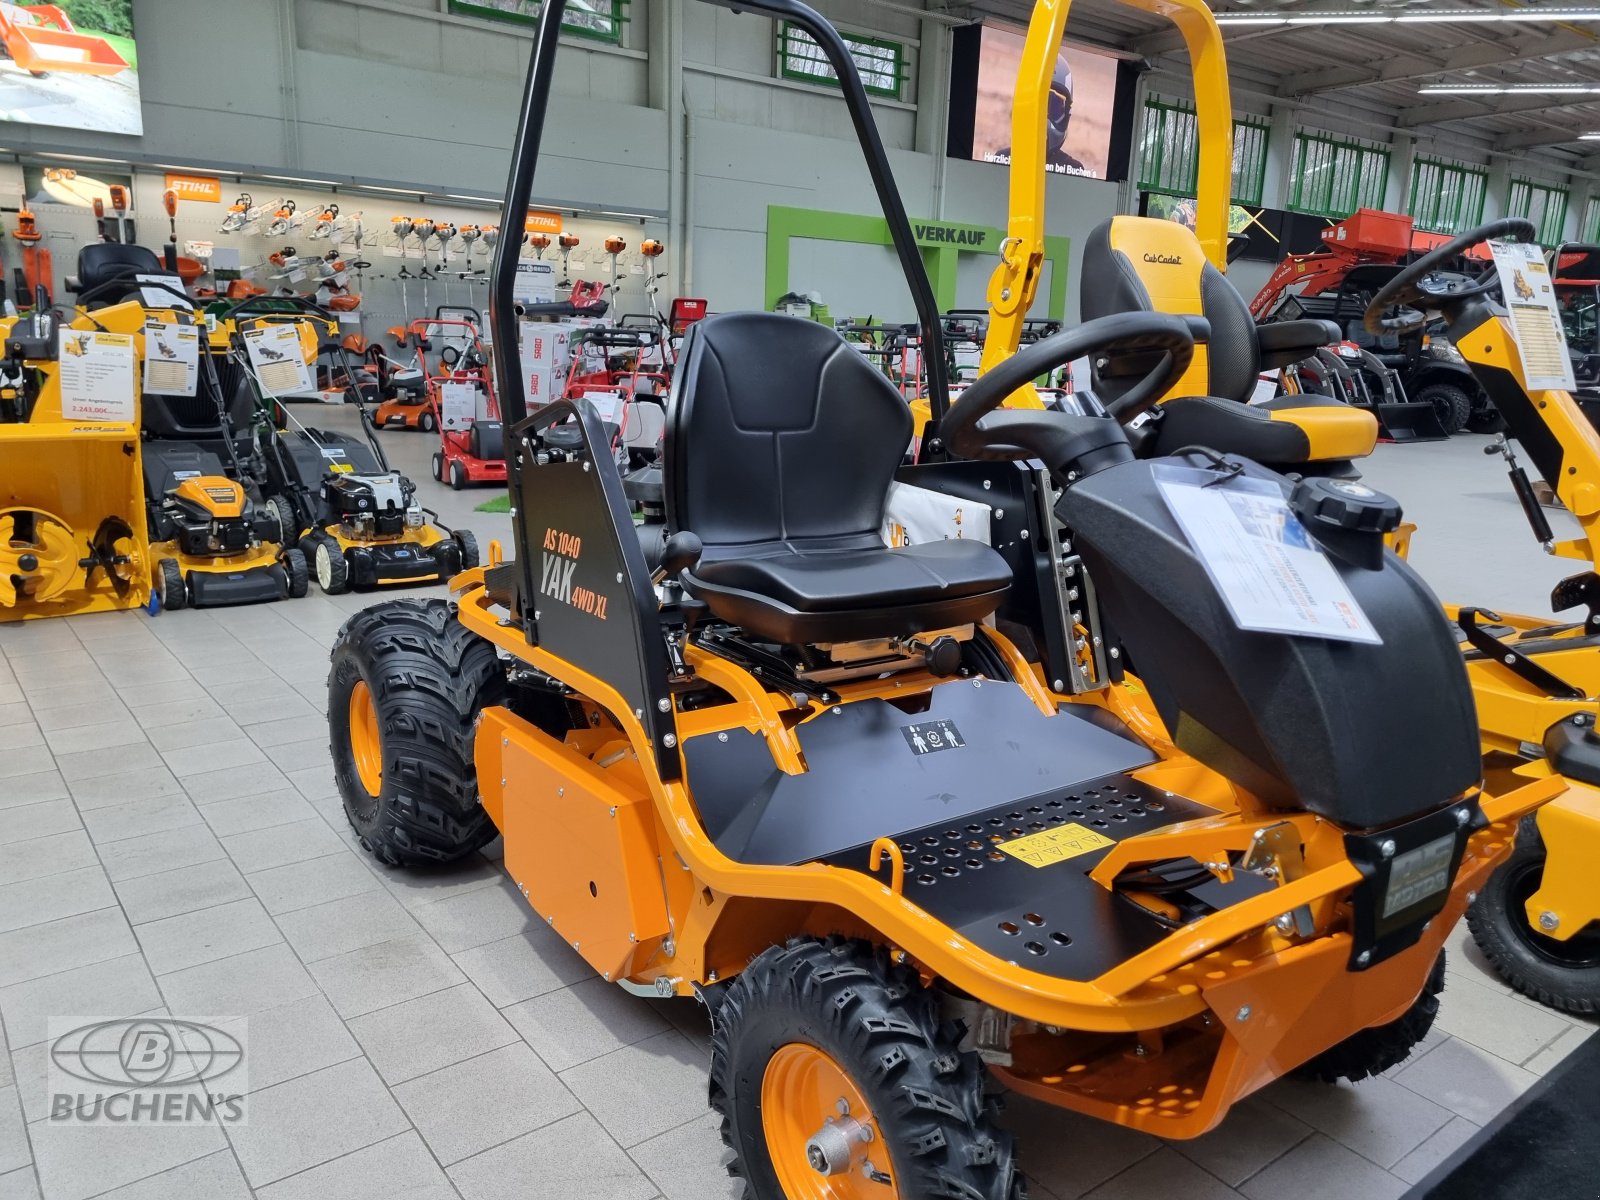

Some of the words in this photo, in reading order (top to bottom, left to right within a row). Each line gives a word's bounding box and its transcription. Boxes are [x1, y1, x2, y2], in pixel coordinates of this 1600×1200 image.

[173, 181, 214, 193] STIHL
[527, 216, 557, 226] STIHL
[915, 225, 986, 245] VERKAUF
[1143, 253, 1157, 263] Cub
[1157, 254, 1181, 265] Cadet
[533, 338, 542, 359] SABO
[543, 528, 557, 551] AS
[558, 531, 581, 559] 1040
[541, 551, 577, 605] YAK
[571, 586, 595, 613] 4WD
[594, 594, 607, 620] XL
